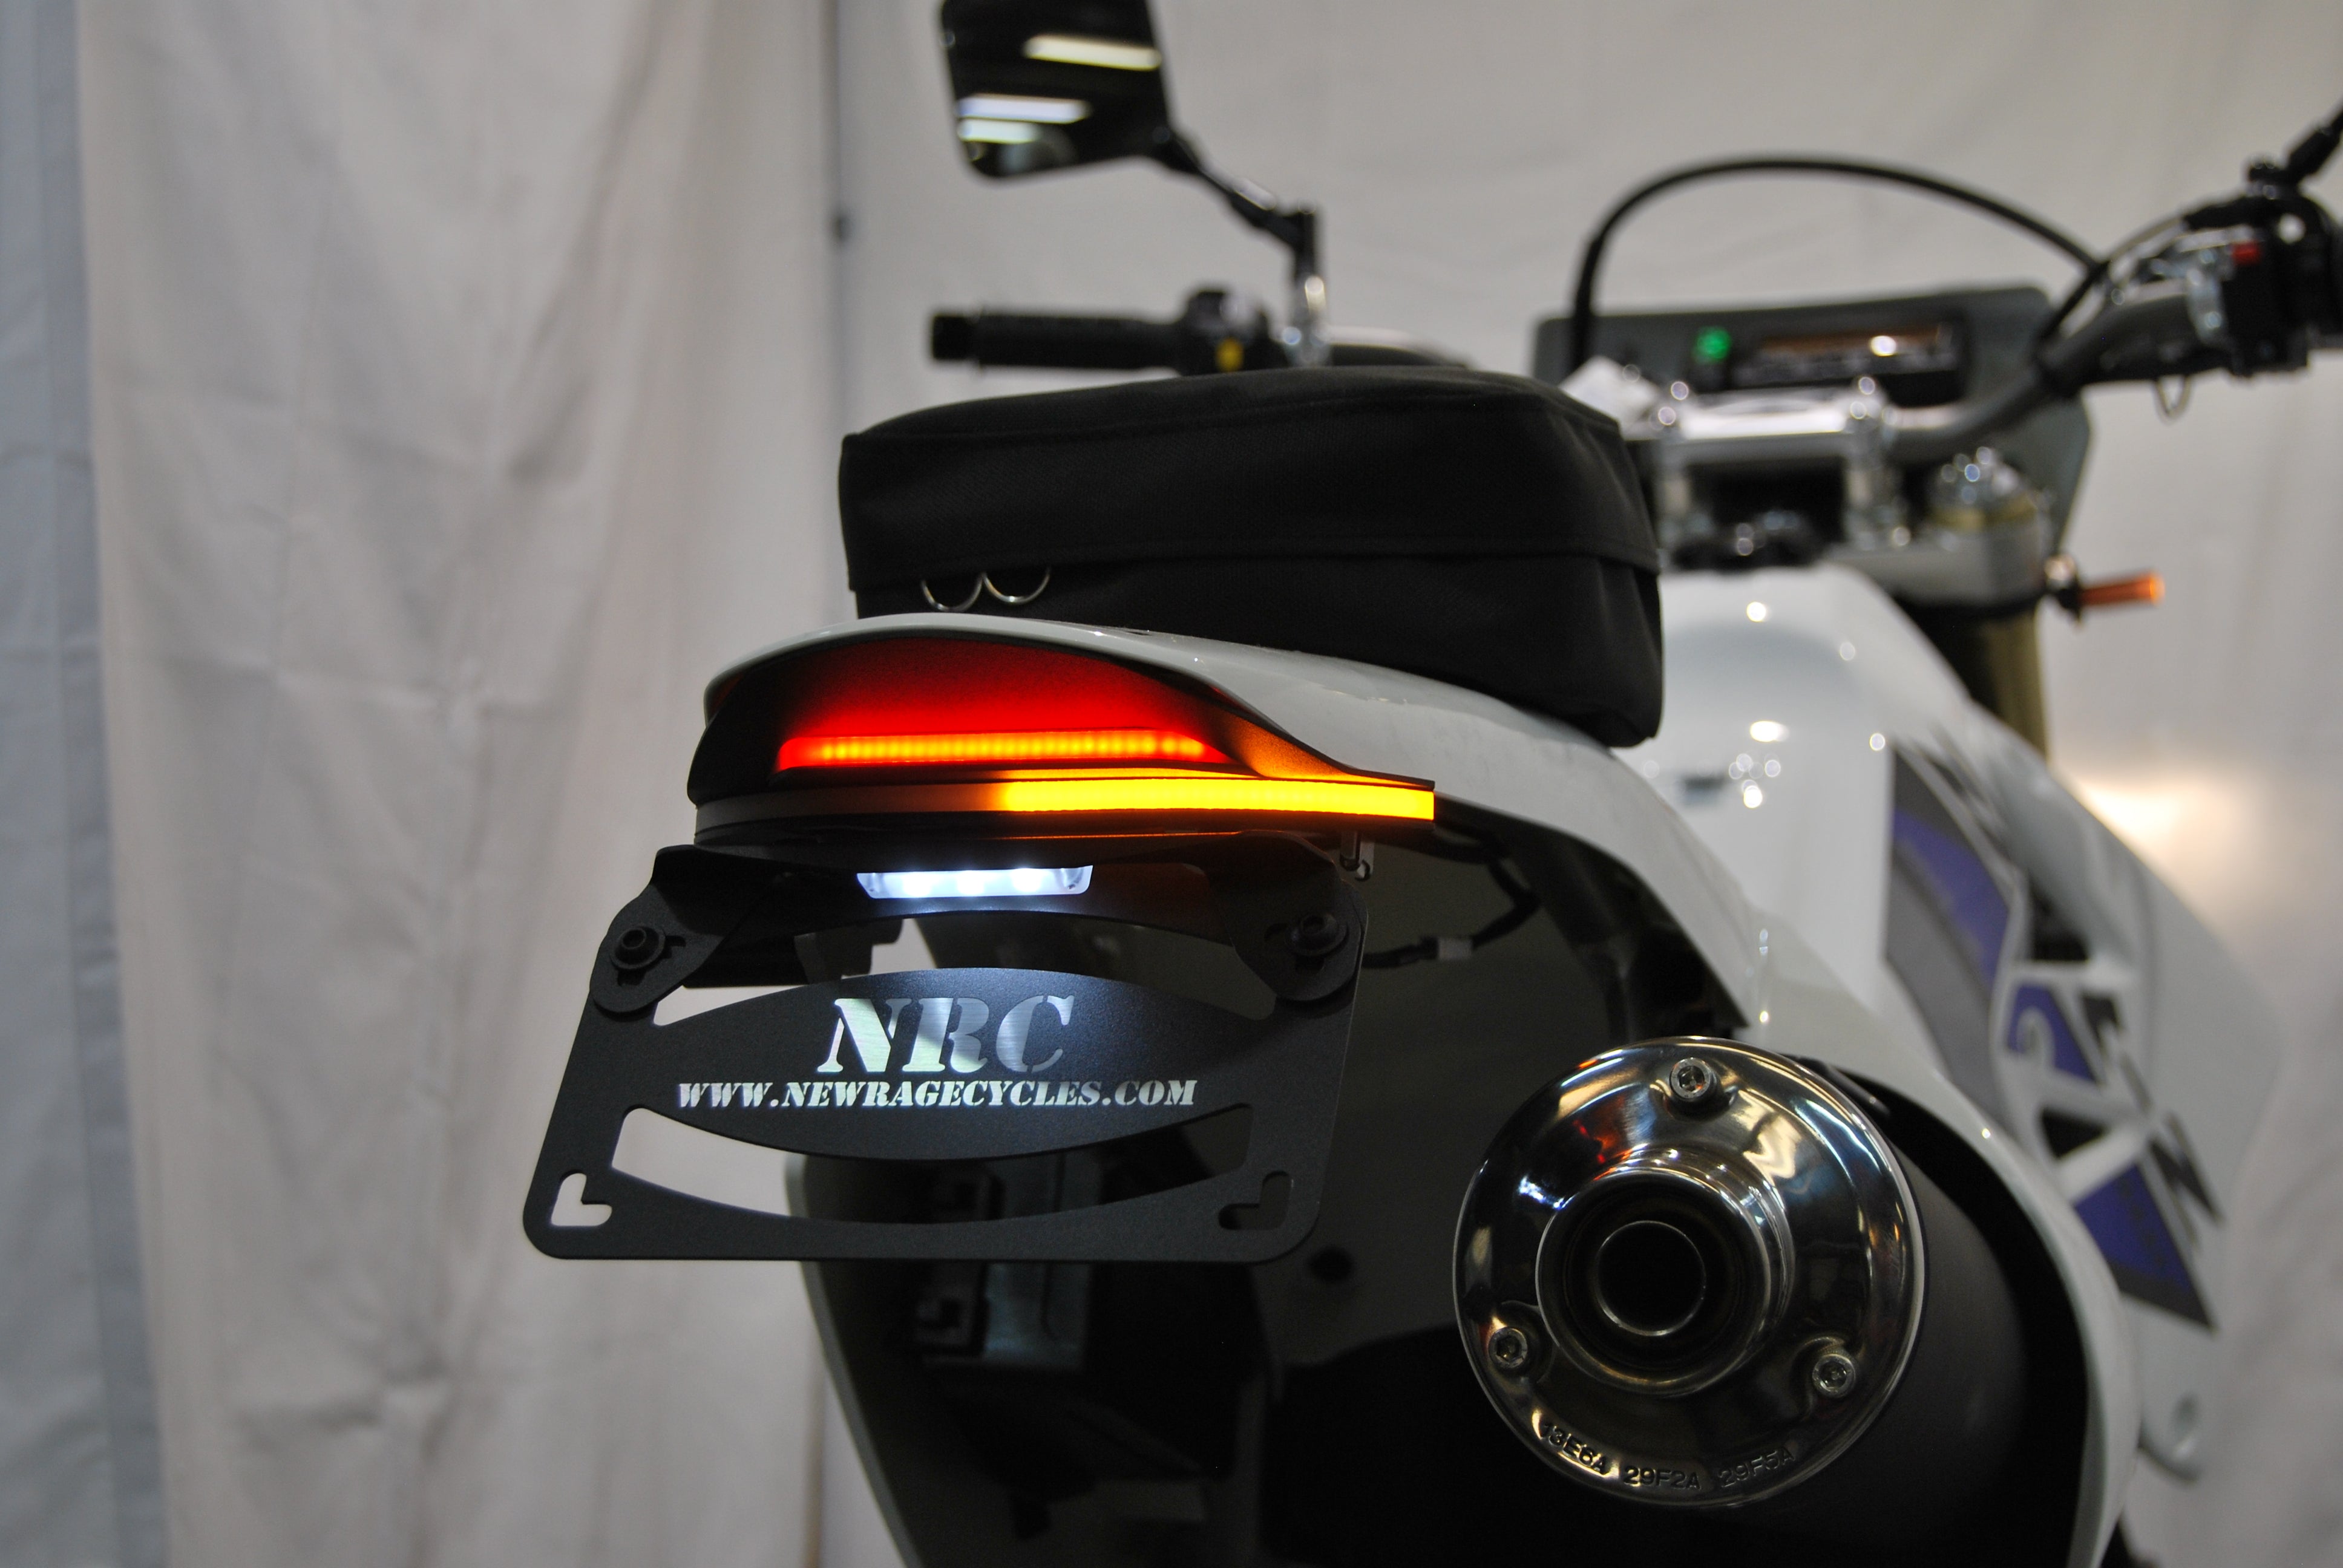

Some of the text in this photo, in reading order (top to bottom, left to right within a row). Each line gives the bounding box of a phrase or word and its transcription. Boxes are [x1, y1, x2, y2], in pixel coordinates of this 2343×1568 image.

[817, 995, 1075, 1073] NRC
[679, 1080, 1198, 1108] WWW.NEWRAGECYCLES.COM
[1623, 1465, 1701, 1490] 29F2A
[1717, 1446, 1796, 1488] 29F5A
